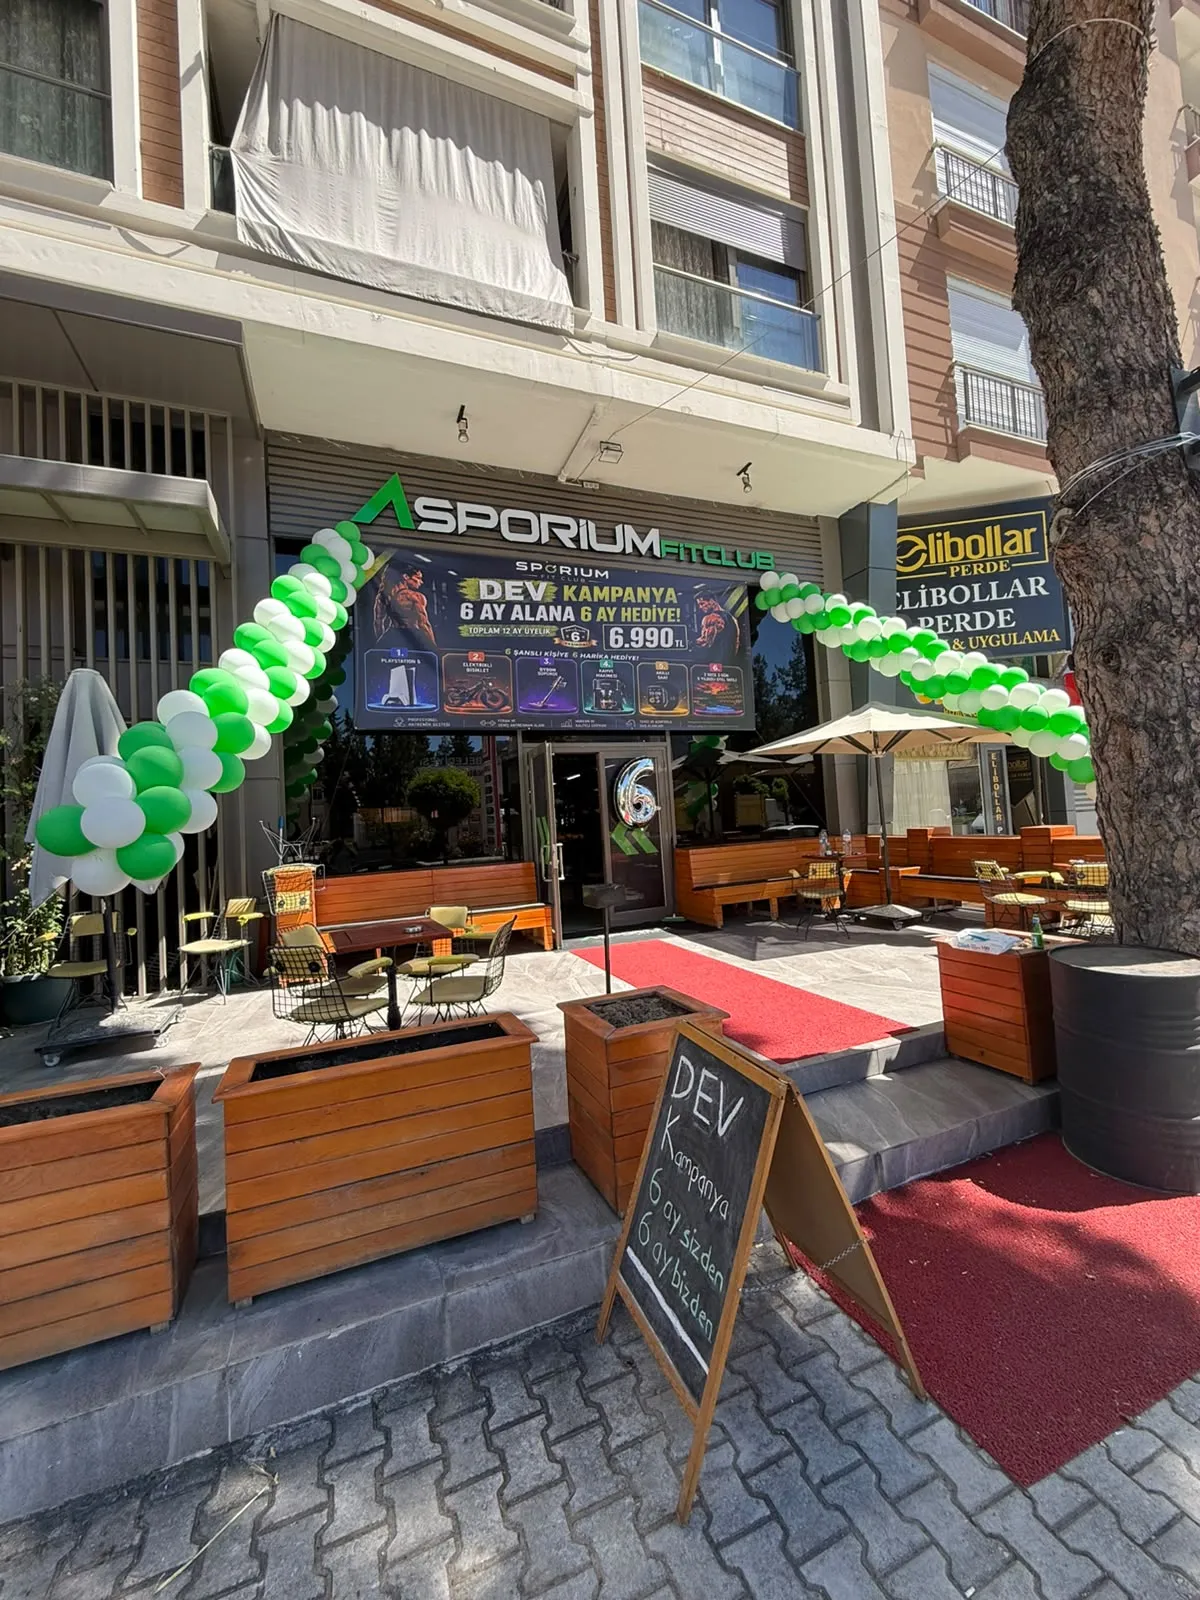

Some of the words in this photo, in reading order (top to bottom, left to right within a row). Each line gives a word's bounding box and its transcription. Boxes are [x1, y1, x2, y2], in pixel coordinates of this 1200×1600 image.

[515, 560, 609, 580] SPORIUM
[949, 560, 1011, 578] PERDE
[479, 579, 548, 601] DEV
[563, 585, 678, 604] KAMPANYA
[460, 602, 474, 620] 6
[480, 603, 506, 621] AY
[510, 604, 576, 622] ALANA
[581, 606, 592, 622] 6
[596, 606, 617, 622] AY
[621, 604, 681, 623] HEDİYE!
[918, 608, 1016, 635] PERDE
[469, 627, 500, 635] TOPLAM
[570, 631, 581, 642] 6
[609, 626, 674, 649] 6.990
[675, 639, 685, 648] TL
[952, 638, 966, 650] &
[968, 628, 1061, 650] UYGULAMA
[505, 647, 512, 655] 6
[513, 649, 542, 658] ŞANSLI
[671, 1055, 744, 1136] DEV
[661, 1105, 728, 1220] Kampanya
[649, 1168, 663, 1205] 6
[663, 1201, 681, 1235] ay
[680, 1228, 724, 1292] sizden
[638, 1211, 653, 1246] 6
[652, 1242, 673, 1277] ay
[671, 1258, 714, 1344] bizden
